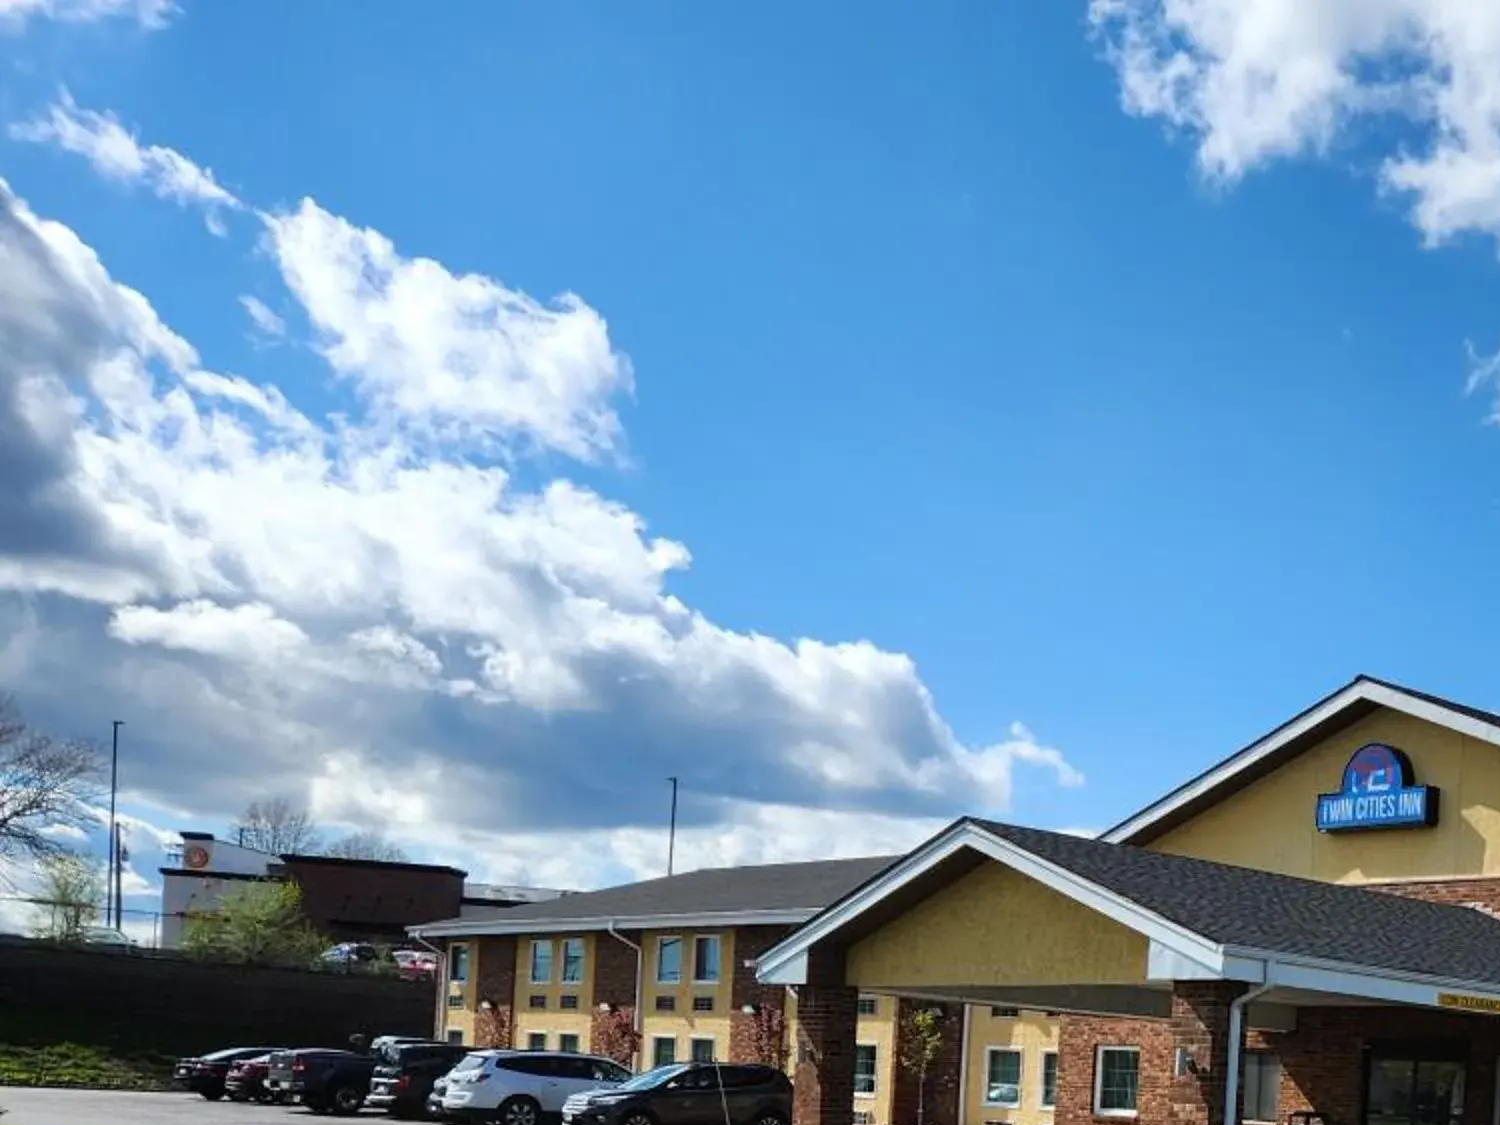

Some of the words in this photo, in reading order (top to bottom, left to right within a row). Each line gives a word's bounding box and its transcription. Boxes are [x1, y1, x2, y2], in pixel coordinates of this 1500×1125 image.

[1322, 799, 1353, 823] TWIN
[1355, 794, 1395, 820] CITIES
[1398, 792, 1422, 817] INN
